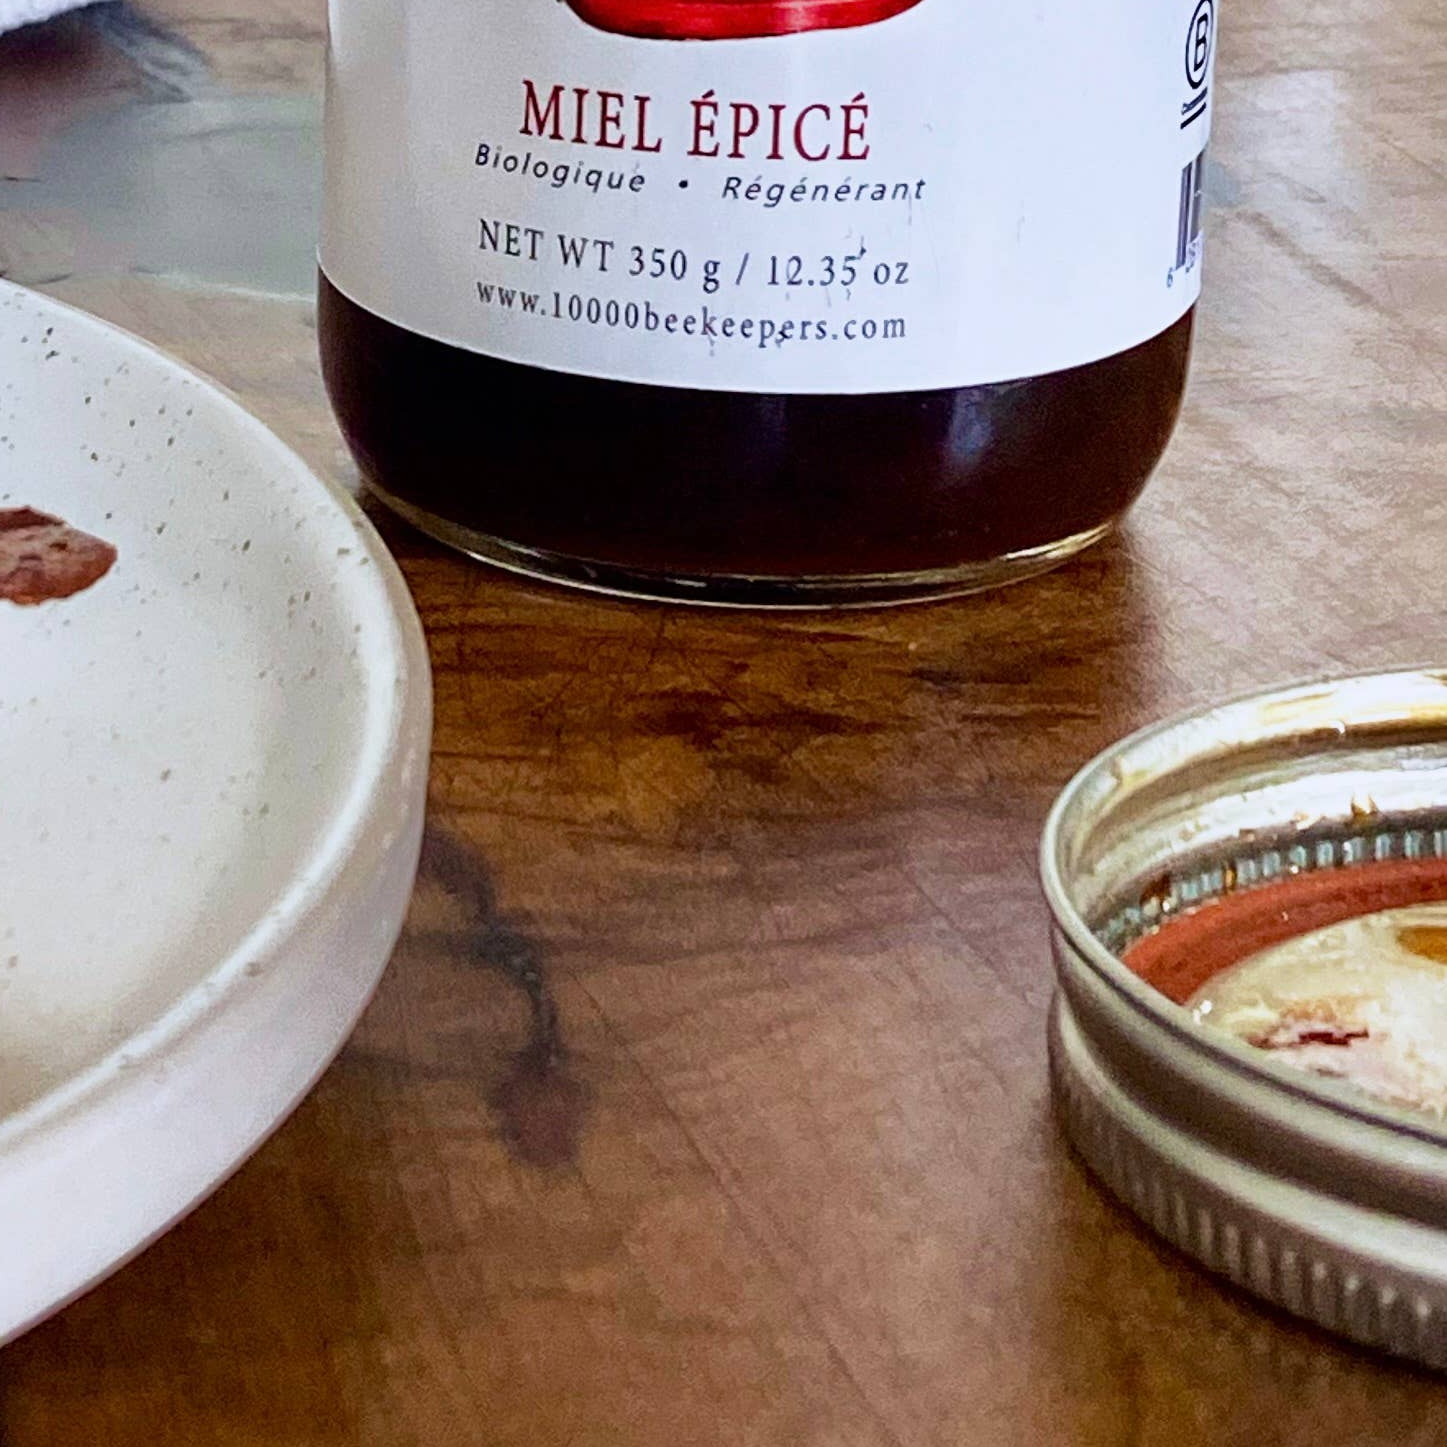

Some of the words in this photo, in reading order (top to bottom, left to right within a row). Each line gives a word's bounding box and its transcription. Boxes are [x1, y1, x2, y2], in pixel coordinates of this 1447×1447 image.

[519, 79, 662, 153] MIEL
[687, 90, 871, 161] ÉPICÉ
[475, 143, 647, 194] Biologique
[721, 175, 927, 209] Régénérant
[478, 219, 544, 262] NET
[558, 234, 615, 273] WT
[629, 245, 688, 281] 350
[702, 258, 721, 294] g
[767, 255, 858, 287] 12.35
[872, 260, 910, 286] oz
[476, 281, 907, 348] www.10000beekeepers.com
